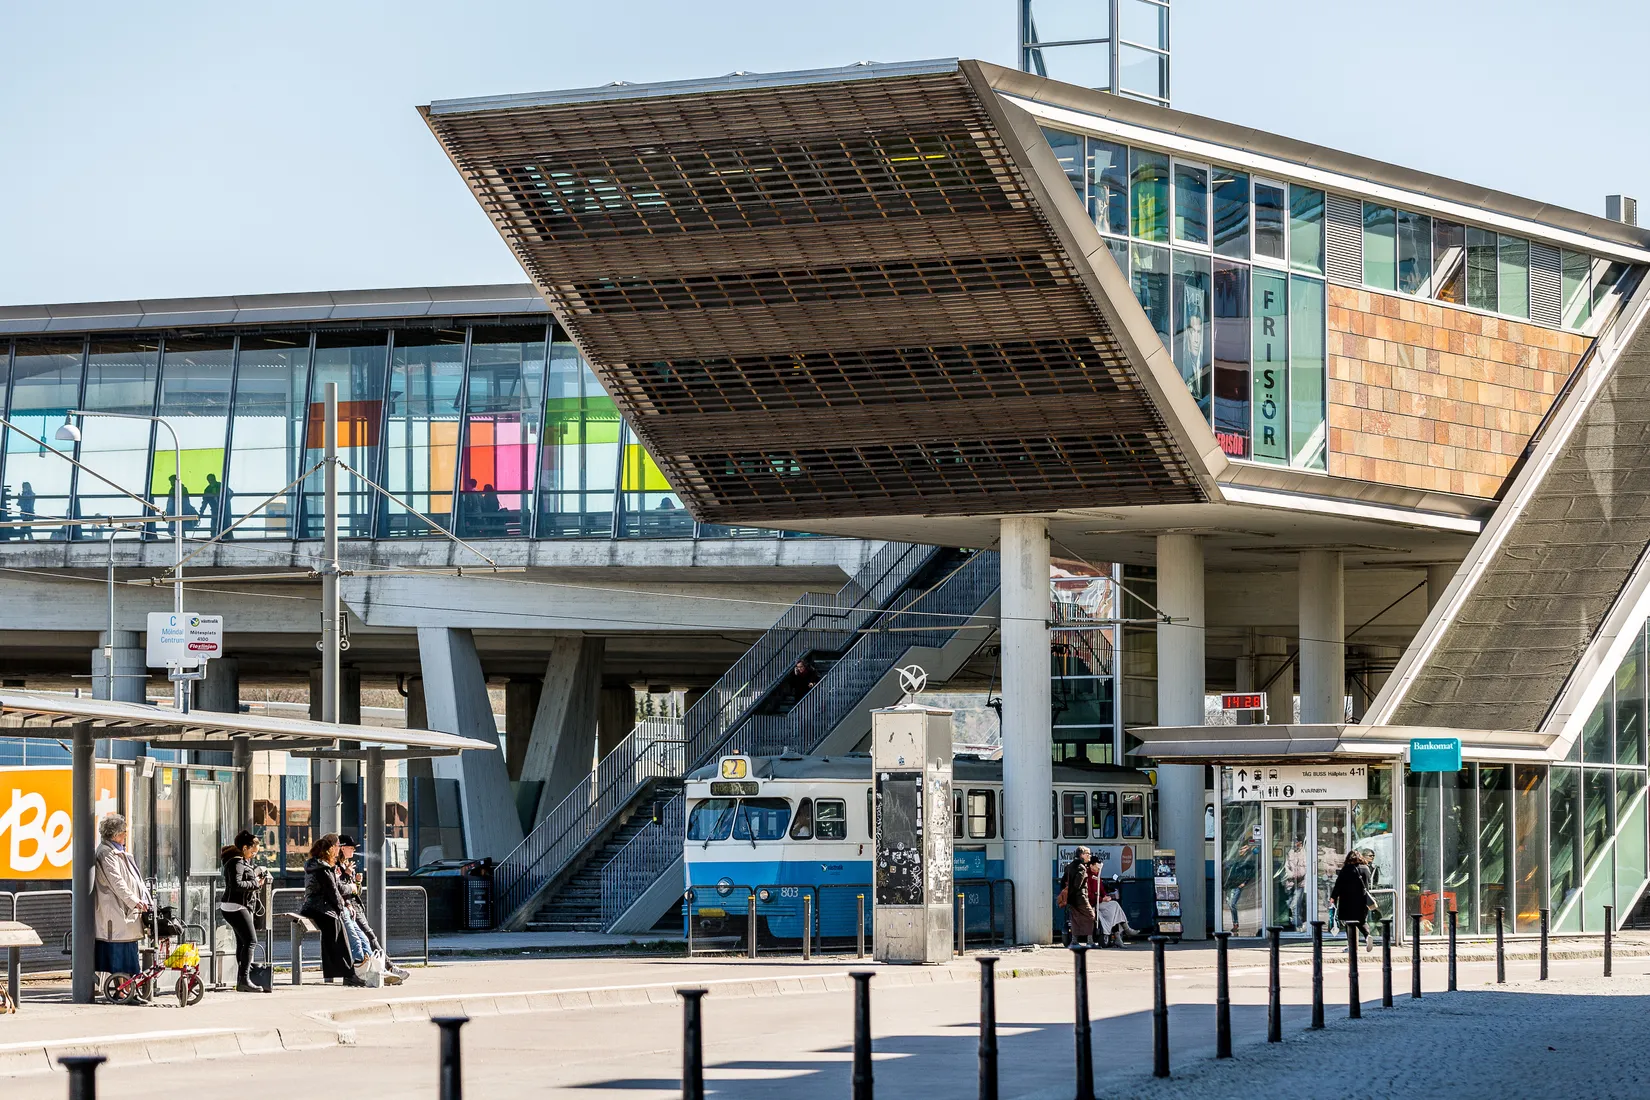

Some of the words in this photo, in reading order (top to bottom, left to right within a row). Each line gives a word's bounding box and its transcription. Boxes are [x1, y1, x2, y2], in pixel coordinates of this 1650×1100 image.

[1262, 290, 1276, 446] FRISÖR
[170, 615, 177, 627] C
[1413, 741, 1454, 750] Bankomat
[730, 759, 740, 775] 2
[1349, 767, 1365, 776] 4-11
[781, 887, 799, 898] 803
